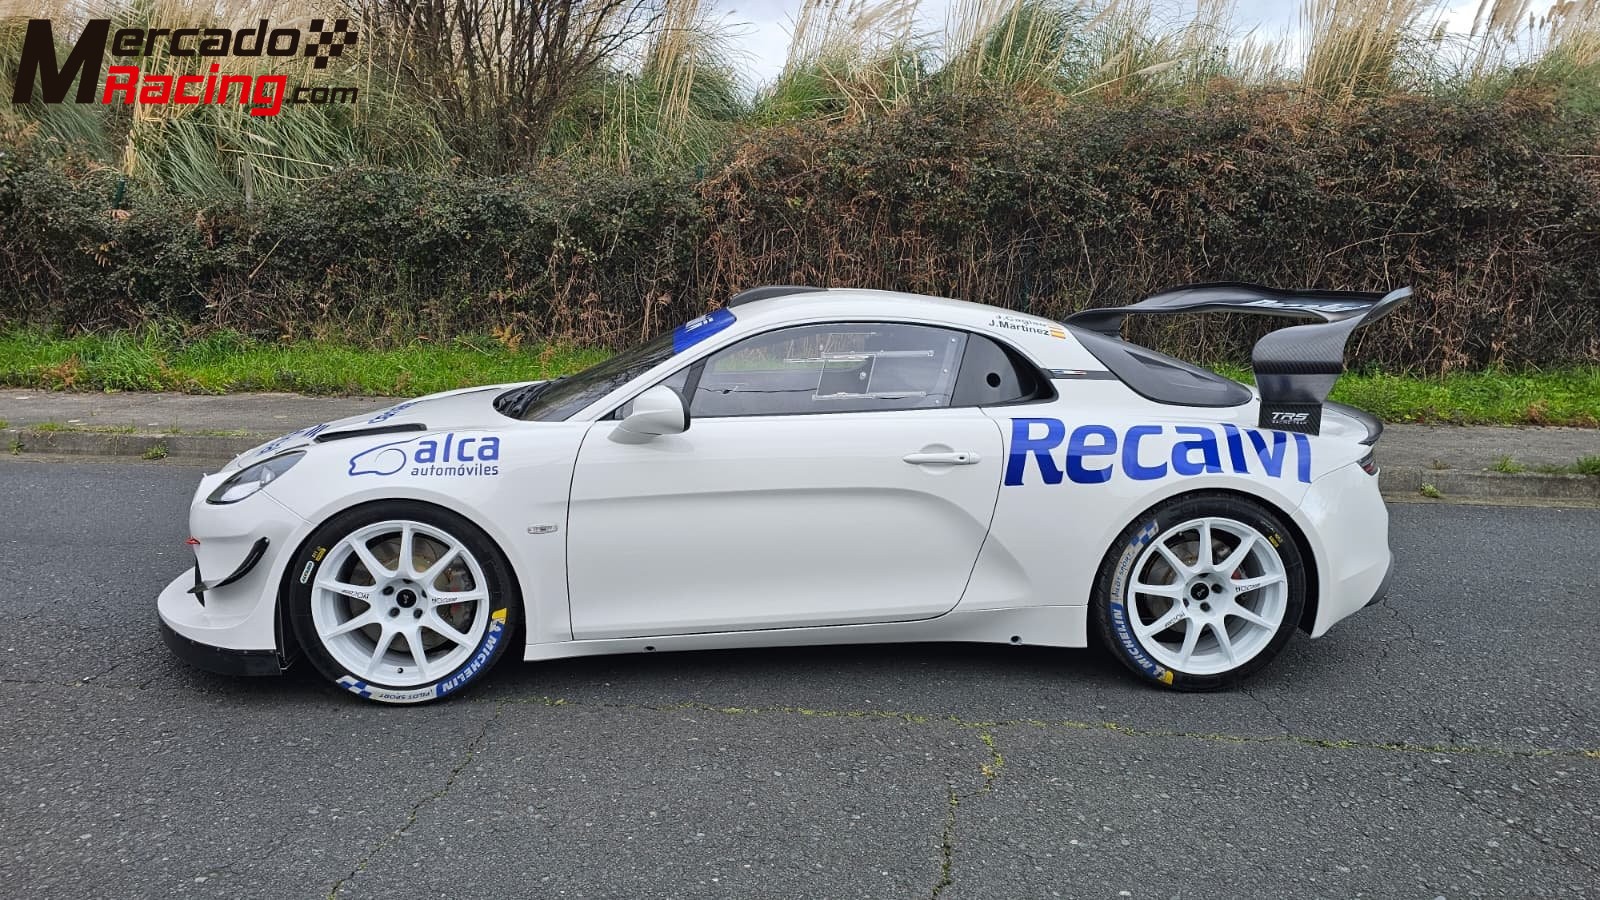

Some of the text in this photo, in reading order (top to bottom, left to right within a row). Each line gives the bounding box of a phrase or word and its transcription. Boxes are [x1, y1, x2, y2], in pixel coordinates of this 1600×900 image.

[1271, 411, 1310, 421] TRS
[413, 432, 500, 464] alca
[410, 463, 499, 477] automóviles
[1112, 607, 1154, 670] MICHELIN
[442, 635, 499, 692] MICHELIN
